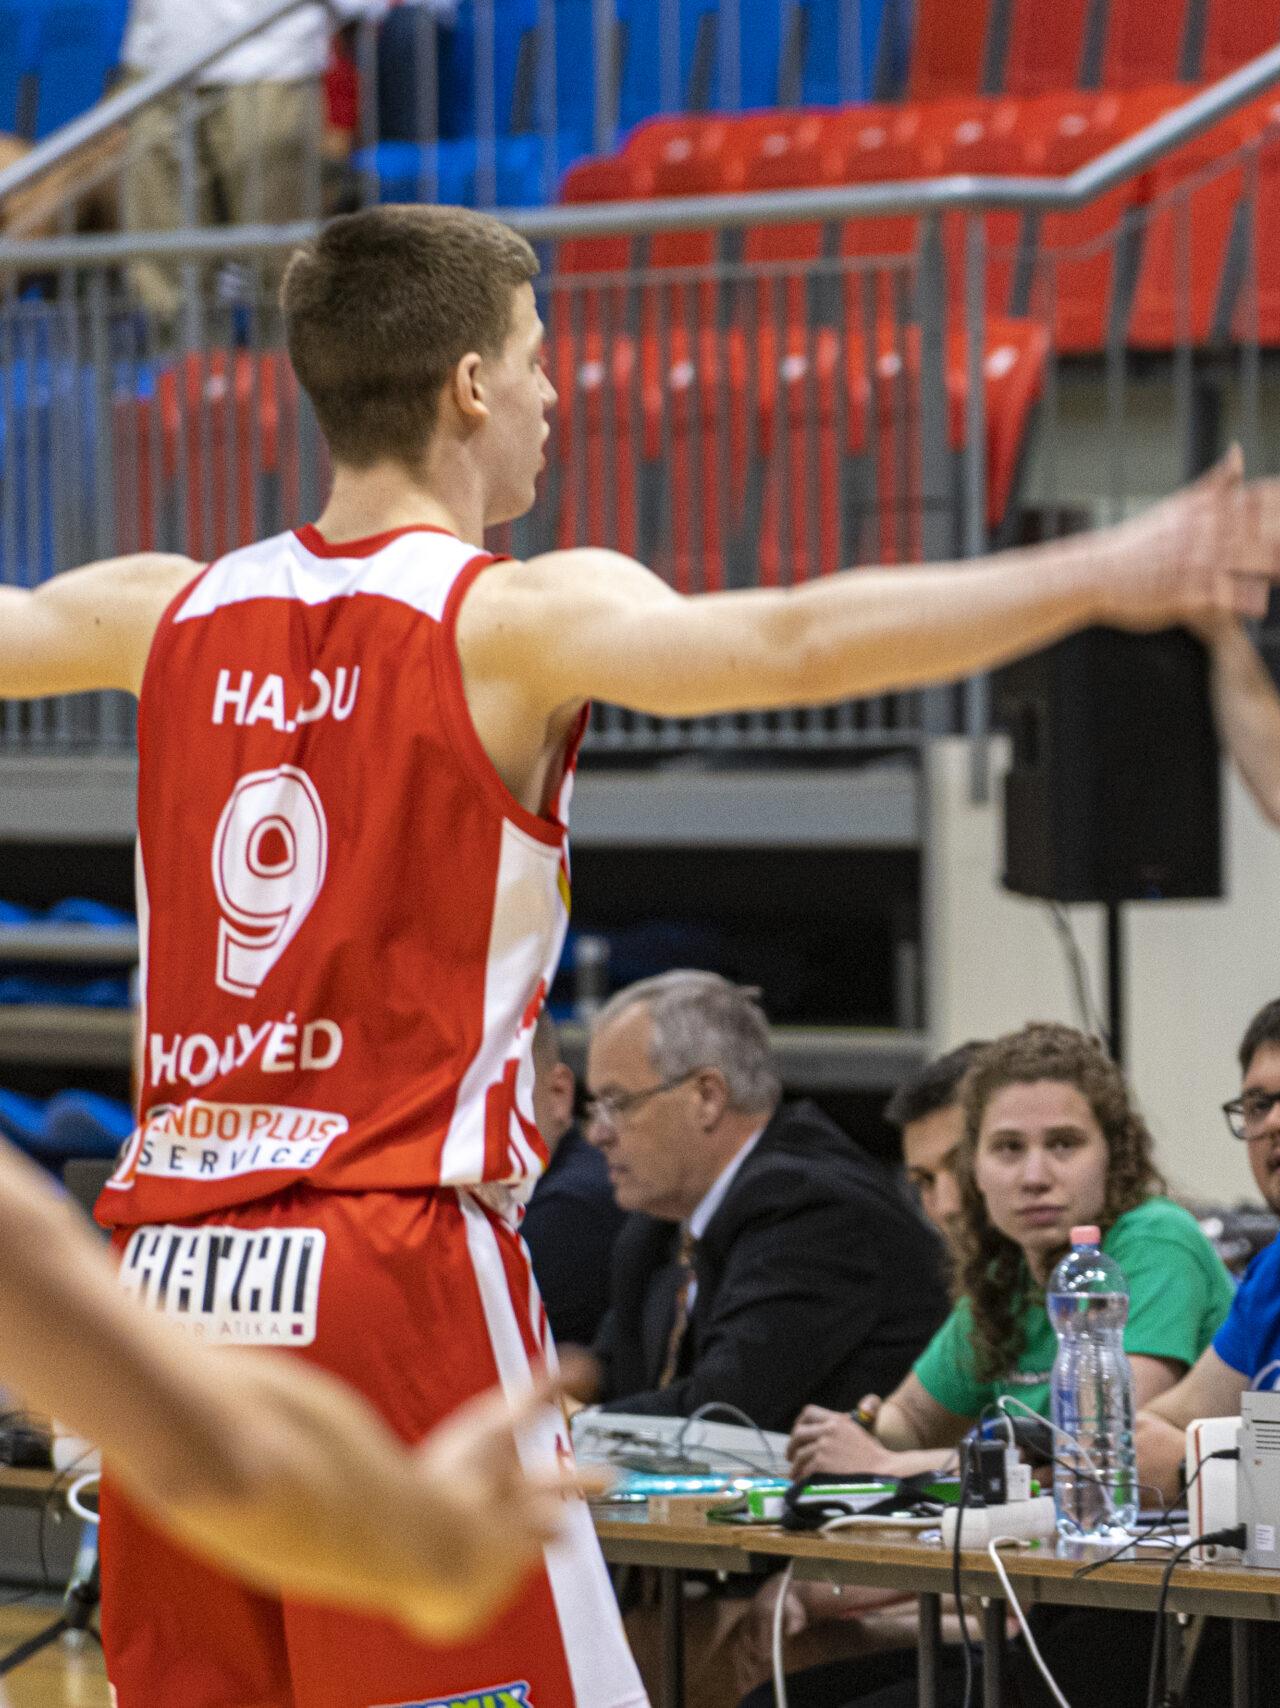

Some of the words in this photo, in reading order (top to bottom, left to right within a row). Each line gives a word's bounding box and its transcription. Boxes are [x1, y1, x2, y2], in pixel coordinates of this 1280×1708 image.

[212, 665, 361, 733] HADU
[211, 763, 328, 998] 9
[139, 1142, 320, 1174] SERVICE
